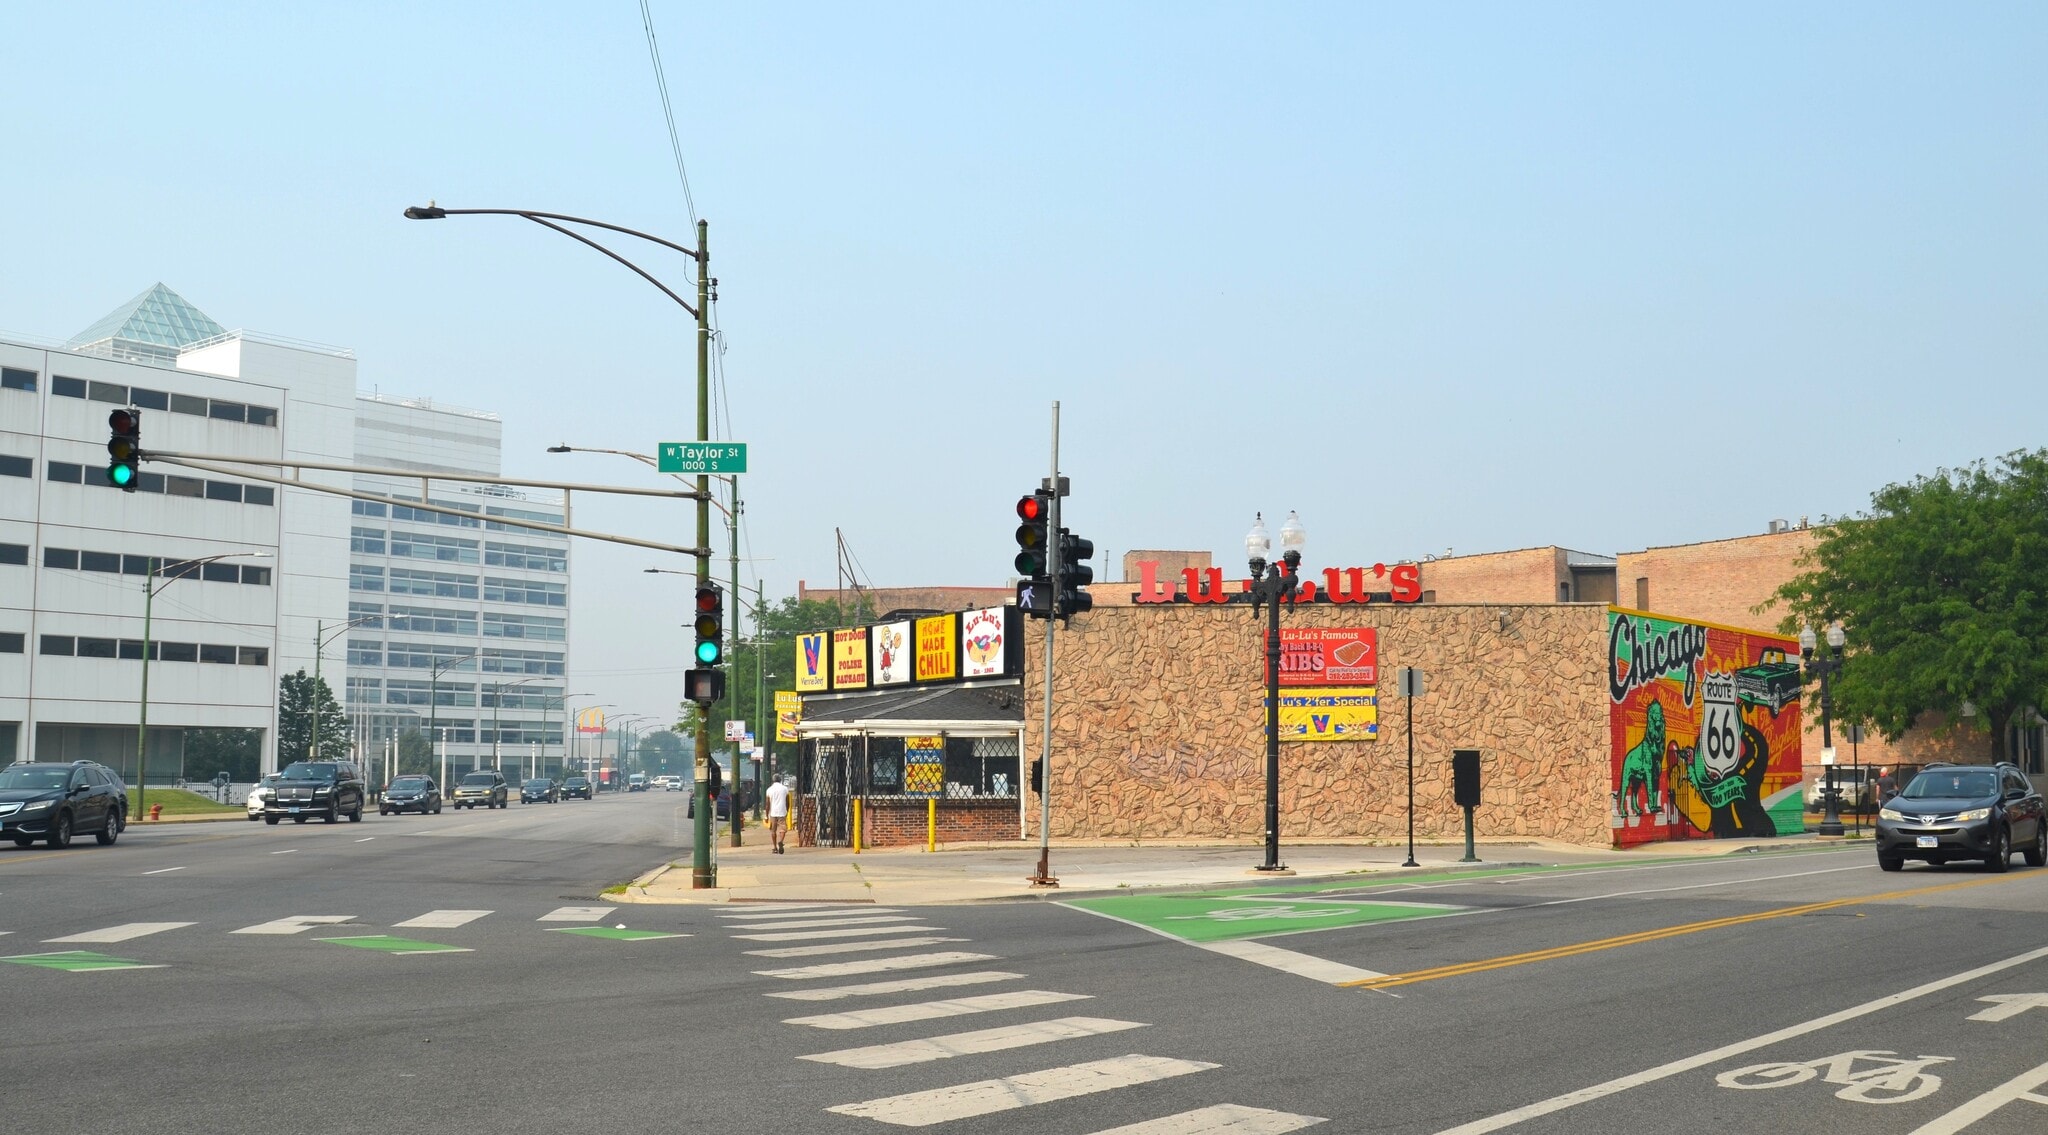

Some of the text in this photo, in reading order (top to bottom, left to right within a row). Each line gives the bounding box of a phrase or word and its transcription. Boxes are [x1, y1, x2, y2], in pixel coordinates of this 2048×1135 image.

[667, 446, 738, 461] W Taylor St
[682, 461, 718, 470] 1000 S
[922, 619, 946, 637] HOME
[965, 609, 1002, 635] Lu-Lu's
[835, 630, 866, 642] HOT DOGS
[1282, 630, 1359, 640] Lu-Lu's Famous
[922, 636, 945, 652] MADE
[838, 659, 863, 670] POLISH
[919, 651, 950, 676] CHILI
[1608, 613, 1706, 707] Chicago
[836, 673, 866, 684] SAUSAGE
[1707, 682, 1732, 699] ROUTE
[1305, 696, 1332, 707] 2'fer
[1334, 696, 1373, 708] Special
[1707, 707, 1736, 760] 66
